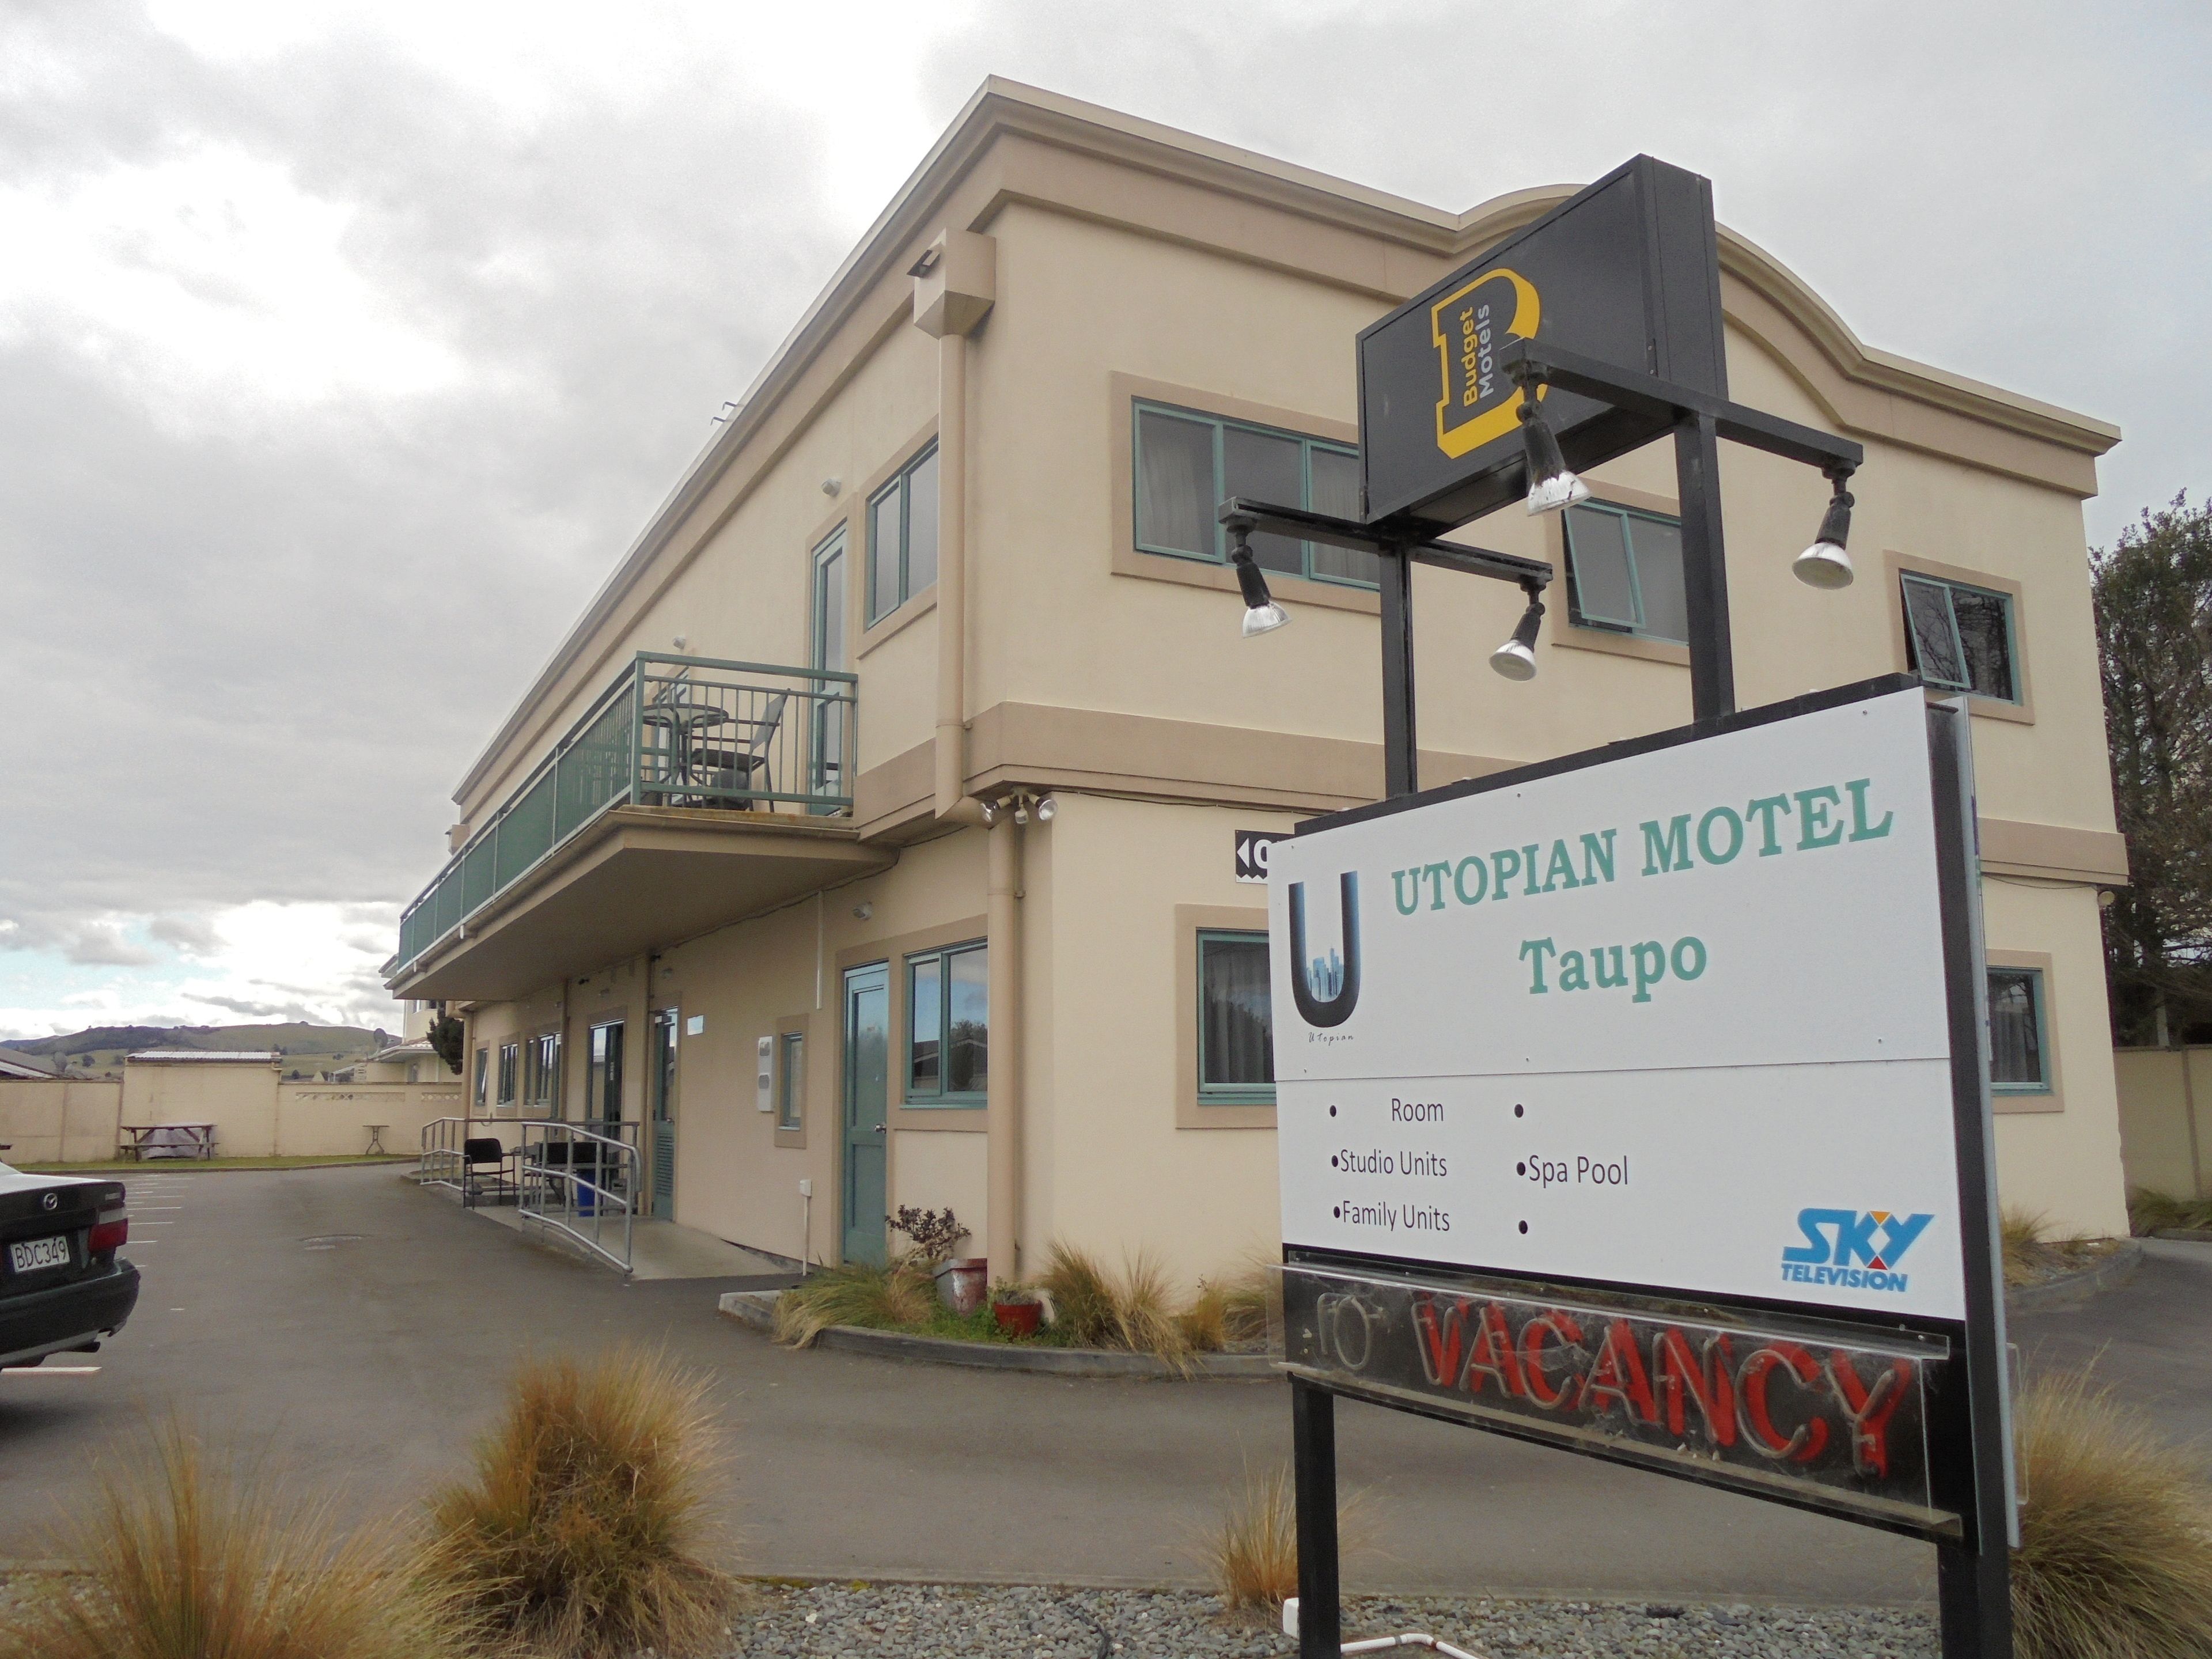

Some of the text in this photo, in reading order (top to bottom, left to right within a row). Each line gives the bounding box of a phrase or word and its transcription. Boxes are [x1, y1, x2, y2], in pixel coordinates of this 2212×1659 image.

[1459, 306, 1478, 407] Budget
[1476, 304, 1494, 399] Motels
[1391, 778, 1893, 916] UTOPIAN MOTEL
[1518, 937, 1707, 1003] Taupo
[1392, 1098, 1444, 1122] Room
[1340, 1149, 1447, 1177] Studio Units
[1528, 1154, 1628, 1188] Spa Pool
[1343, 1200, 1450, 1231] Family Units
[1782, 1208, 1936, 1270] SKY
[15, 1241, 67, 1268] BDC349
[1781, 1263, 1908, 1292] TELEVISION
[1412, 1290, 1910, 1477] VACANCY
